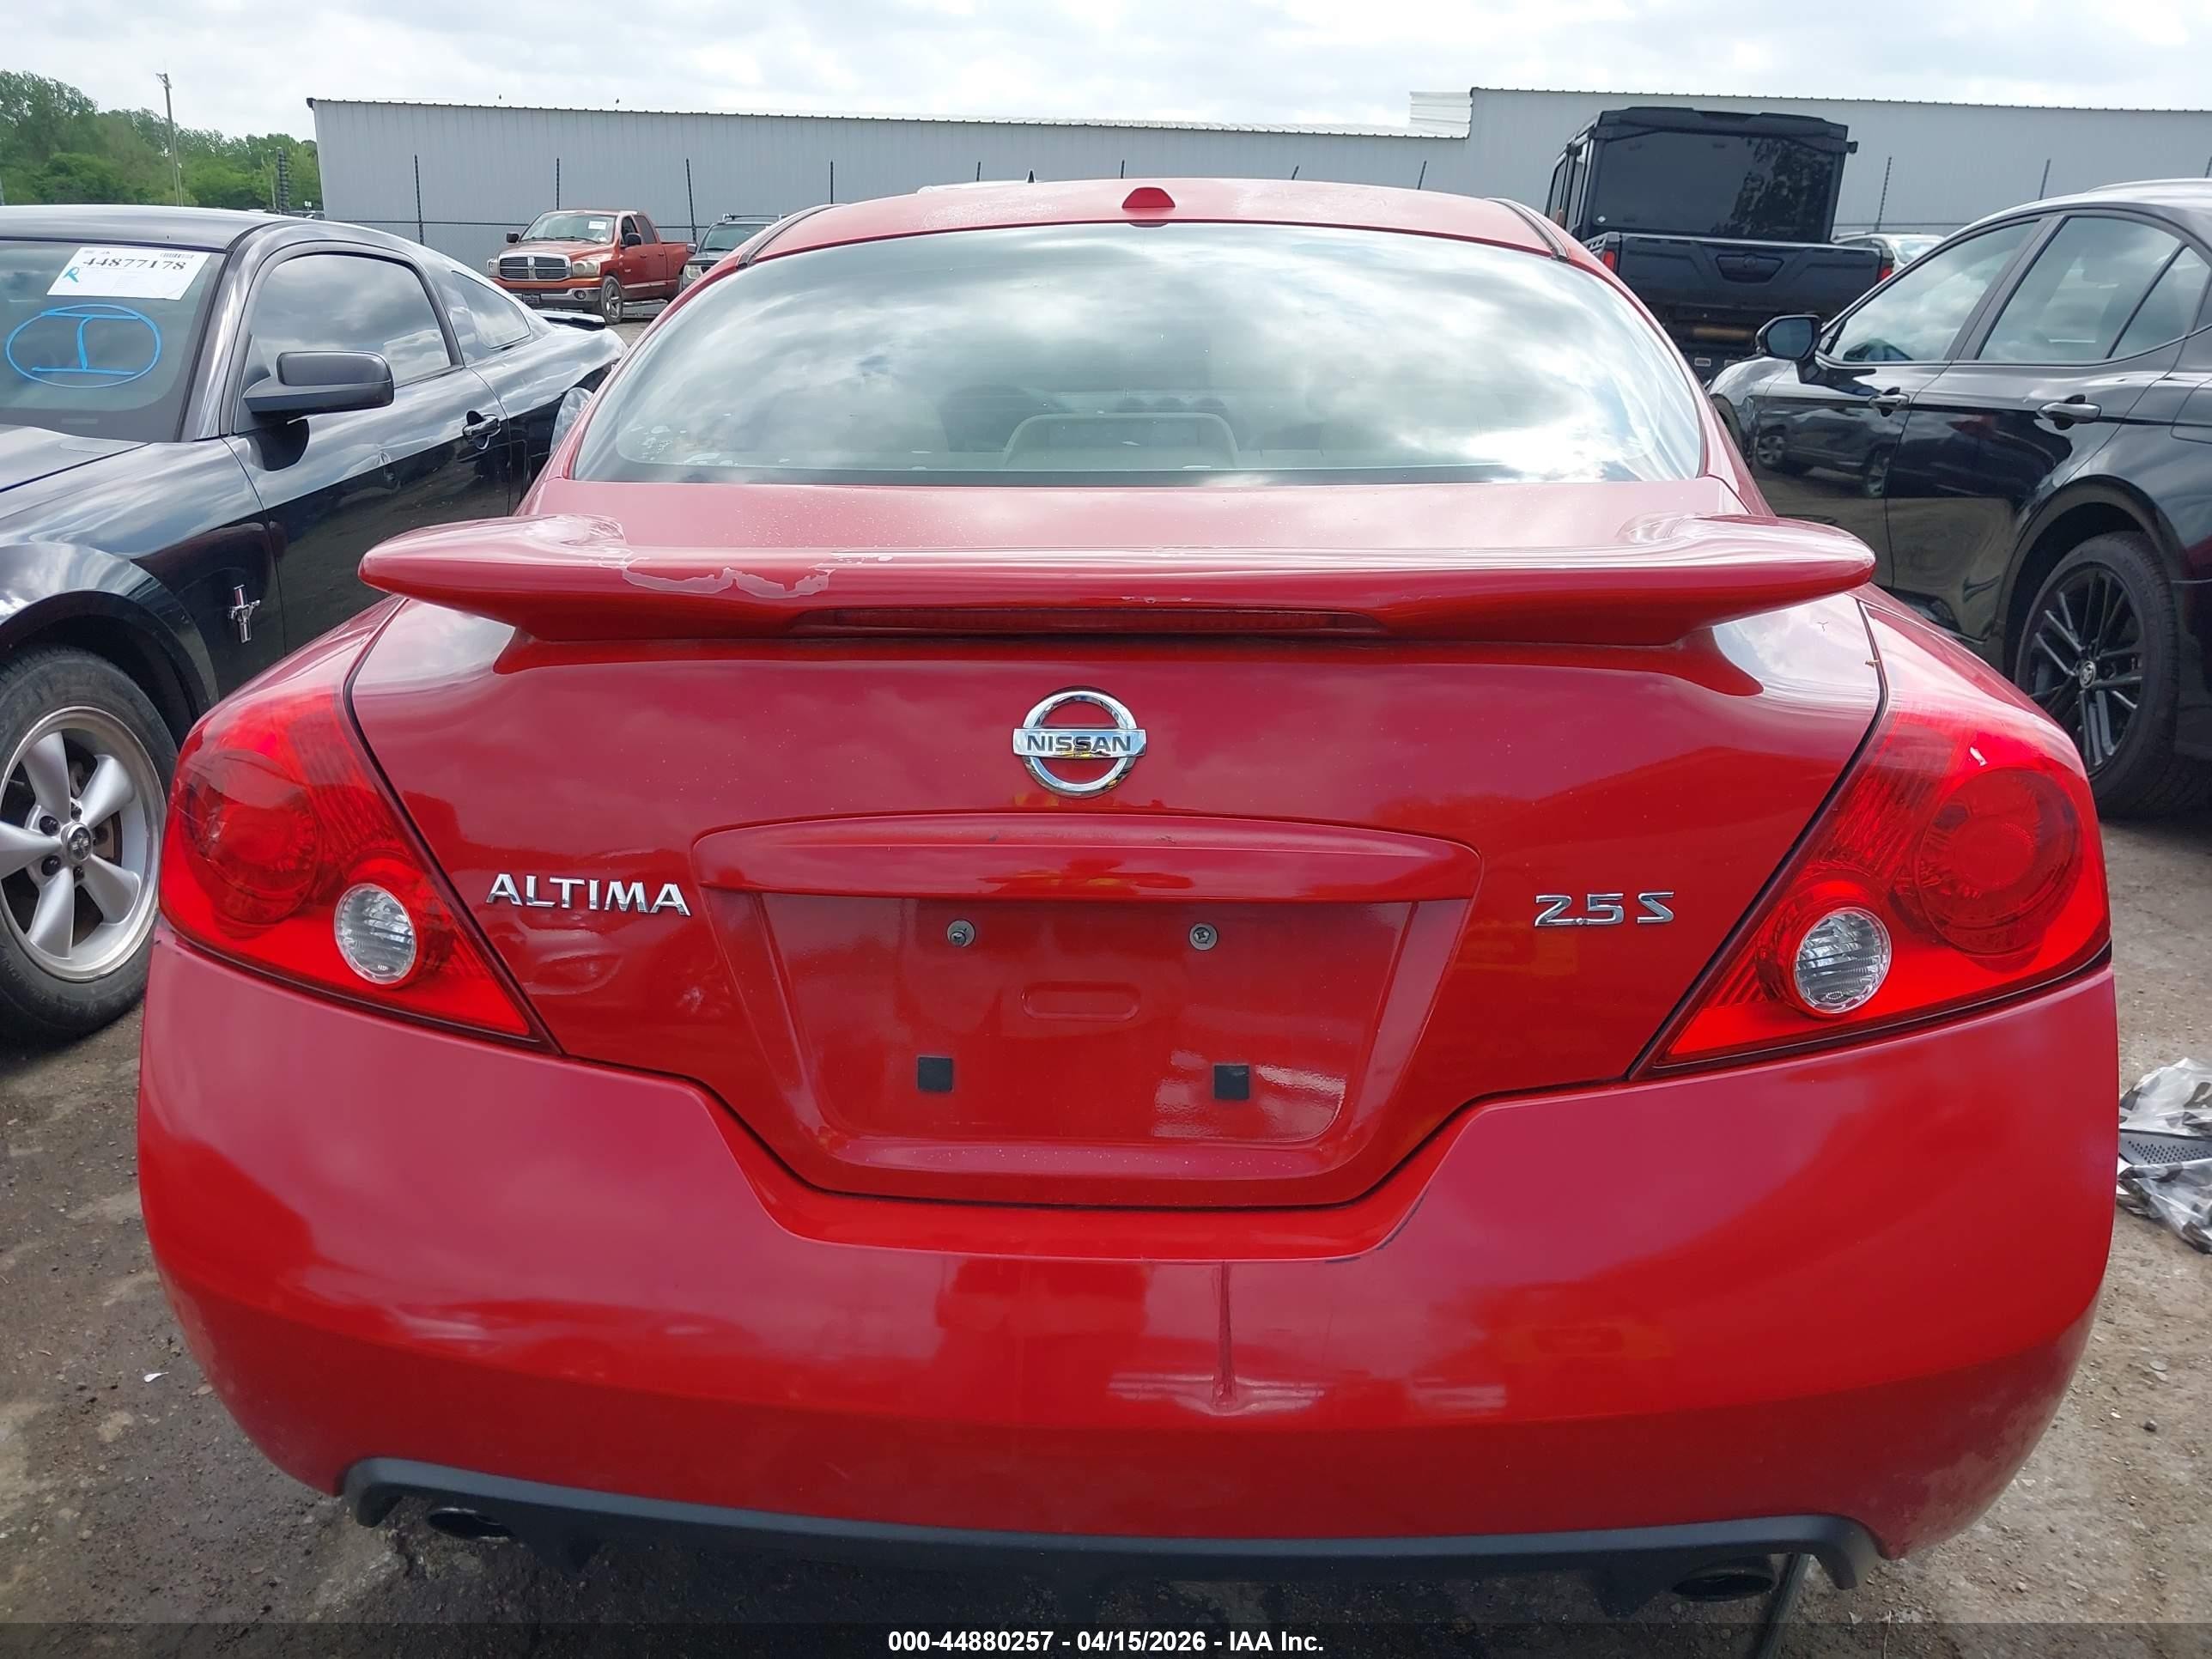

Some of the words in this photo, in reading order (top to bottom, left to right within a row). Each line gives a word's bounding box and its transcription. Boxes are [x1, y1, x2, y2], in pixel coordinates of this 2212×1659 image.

[83, 258, 186, 270] 44877178
[1027, 736, 1131, 752] NISSAN
[486, 872, 691, 917] ALTIMA
[1535, 893, 1624, 927] 2.5
[1637, 892, 1674, 923] S
